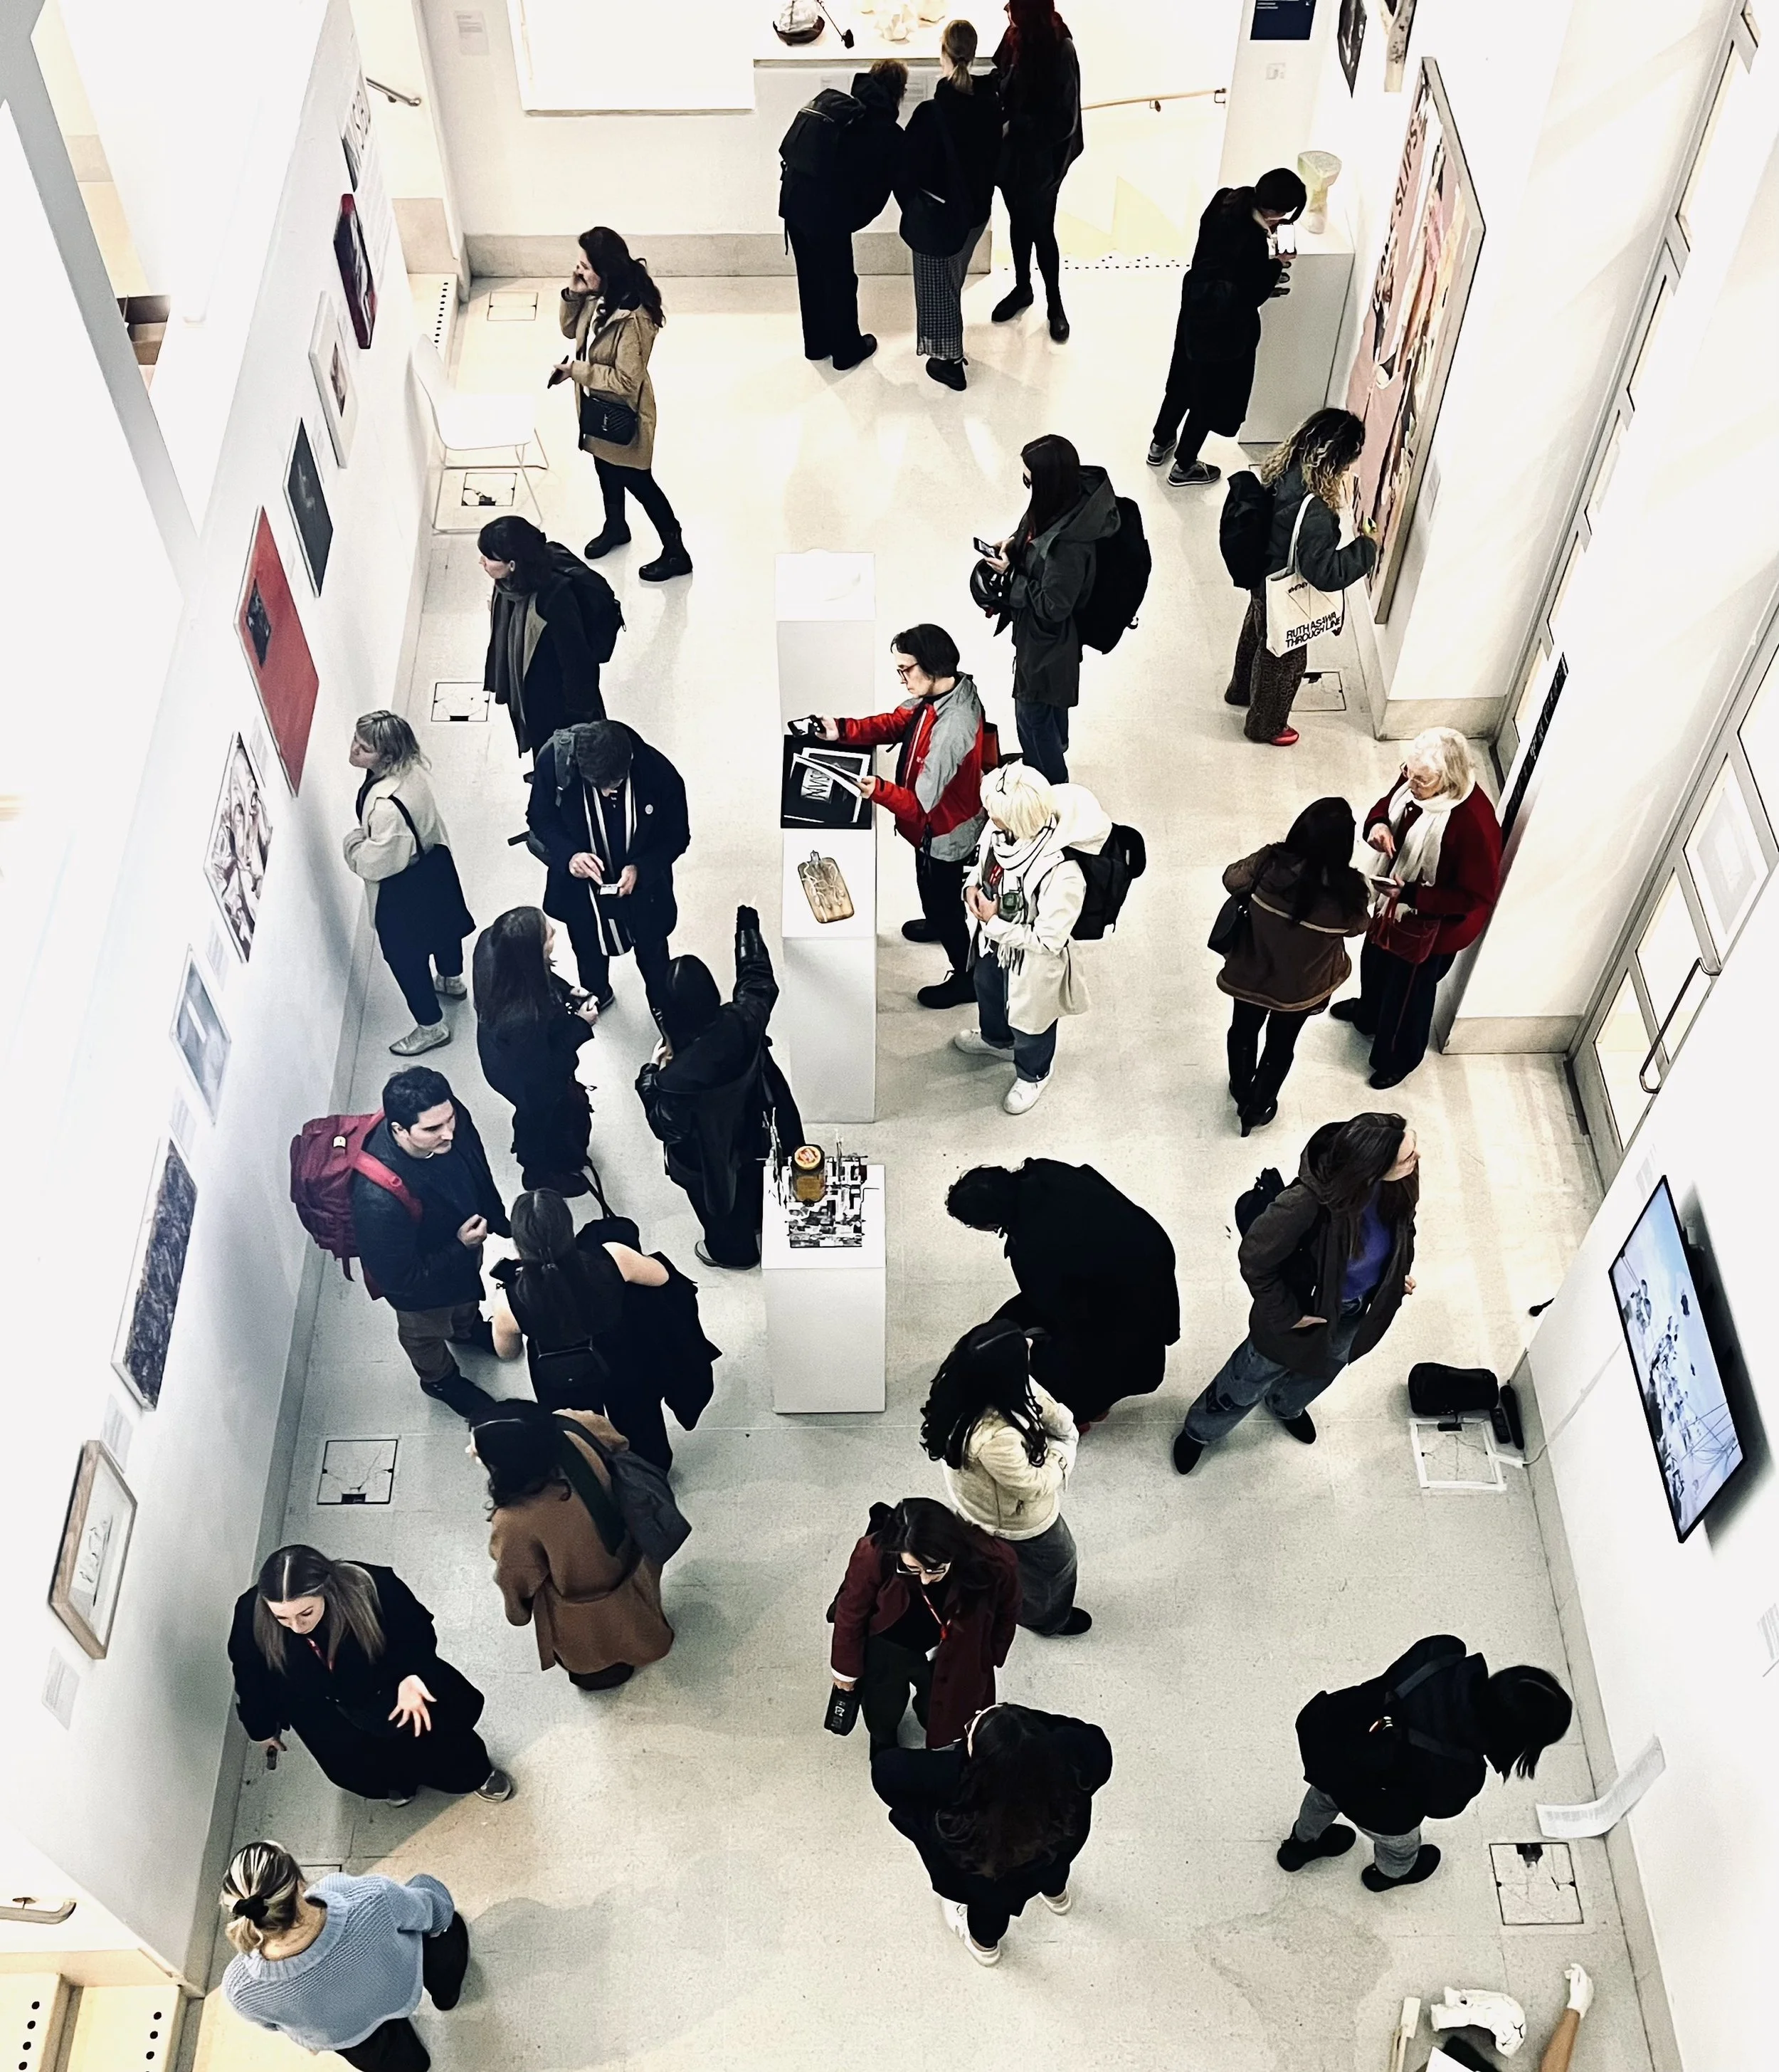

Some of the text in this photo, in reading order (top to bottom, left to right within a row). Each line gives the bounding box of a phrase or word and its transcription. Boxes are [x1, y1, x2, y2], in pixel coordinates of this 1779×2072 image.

[1395, 119, 1418, 216] SLIPS
[1286, 616, 1341, 648] THROUGH LINE
[1287, 624, 1309, 639] RUTH
